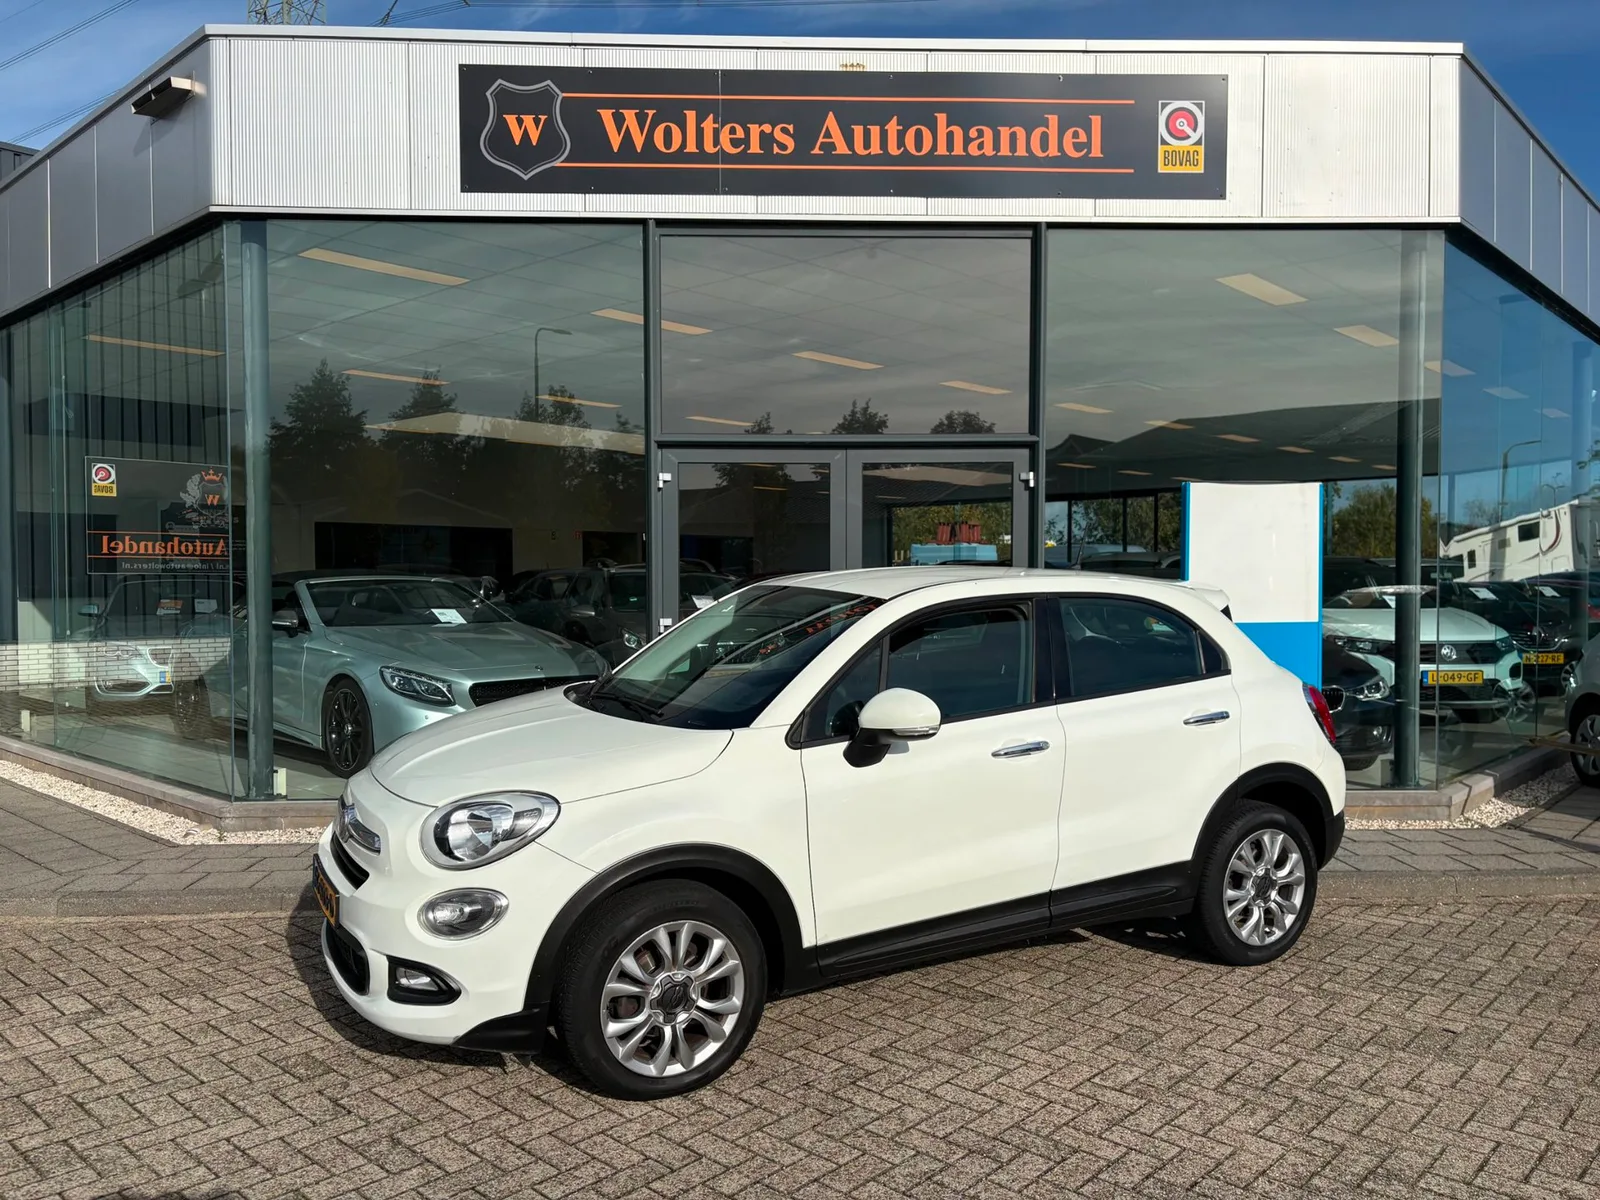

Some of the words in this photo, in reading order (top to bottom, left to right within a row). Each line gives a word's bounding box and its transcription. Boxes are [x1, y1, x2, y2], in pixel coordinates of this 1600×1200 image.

[503, 114, 548, 146] W
[597, 108, 796, 155] Wolters
[810, 111, 1105, 158] Autohandel
[1163, 149, 1199, 167] BOVAG
[1431, 672, 1480, 682] L-049-GF
